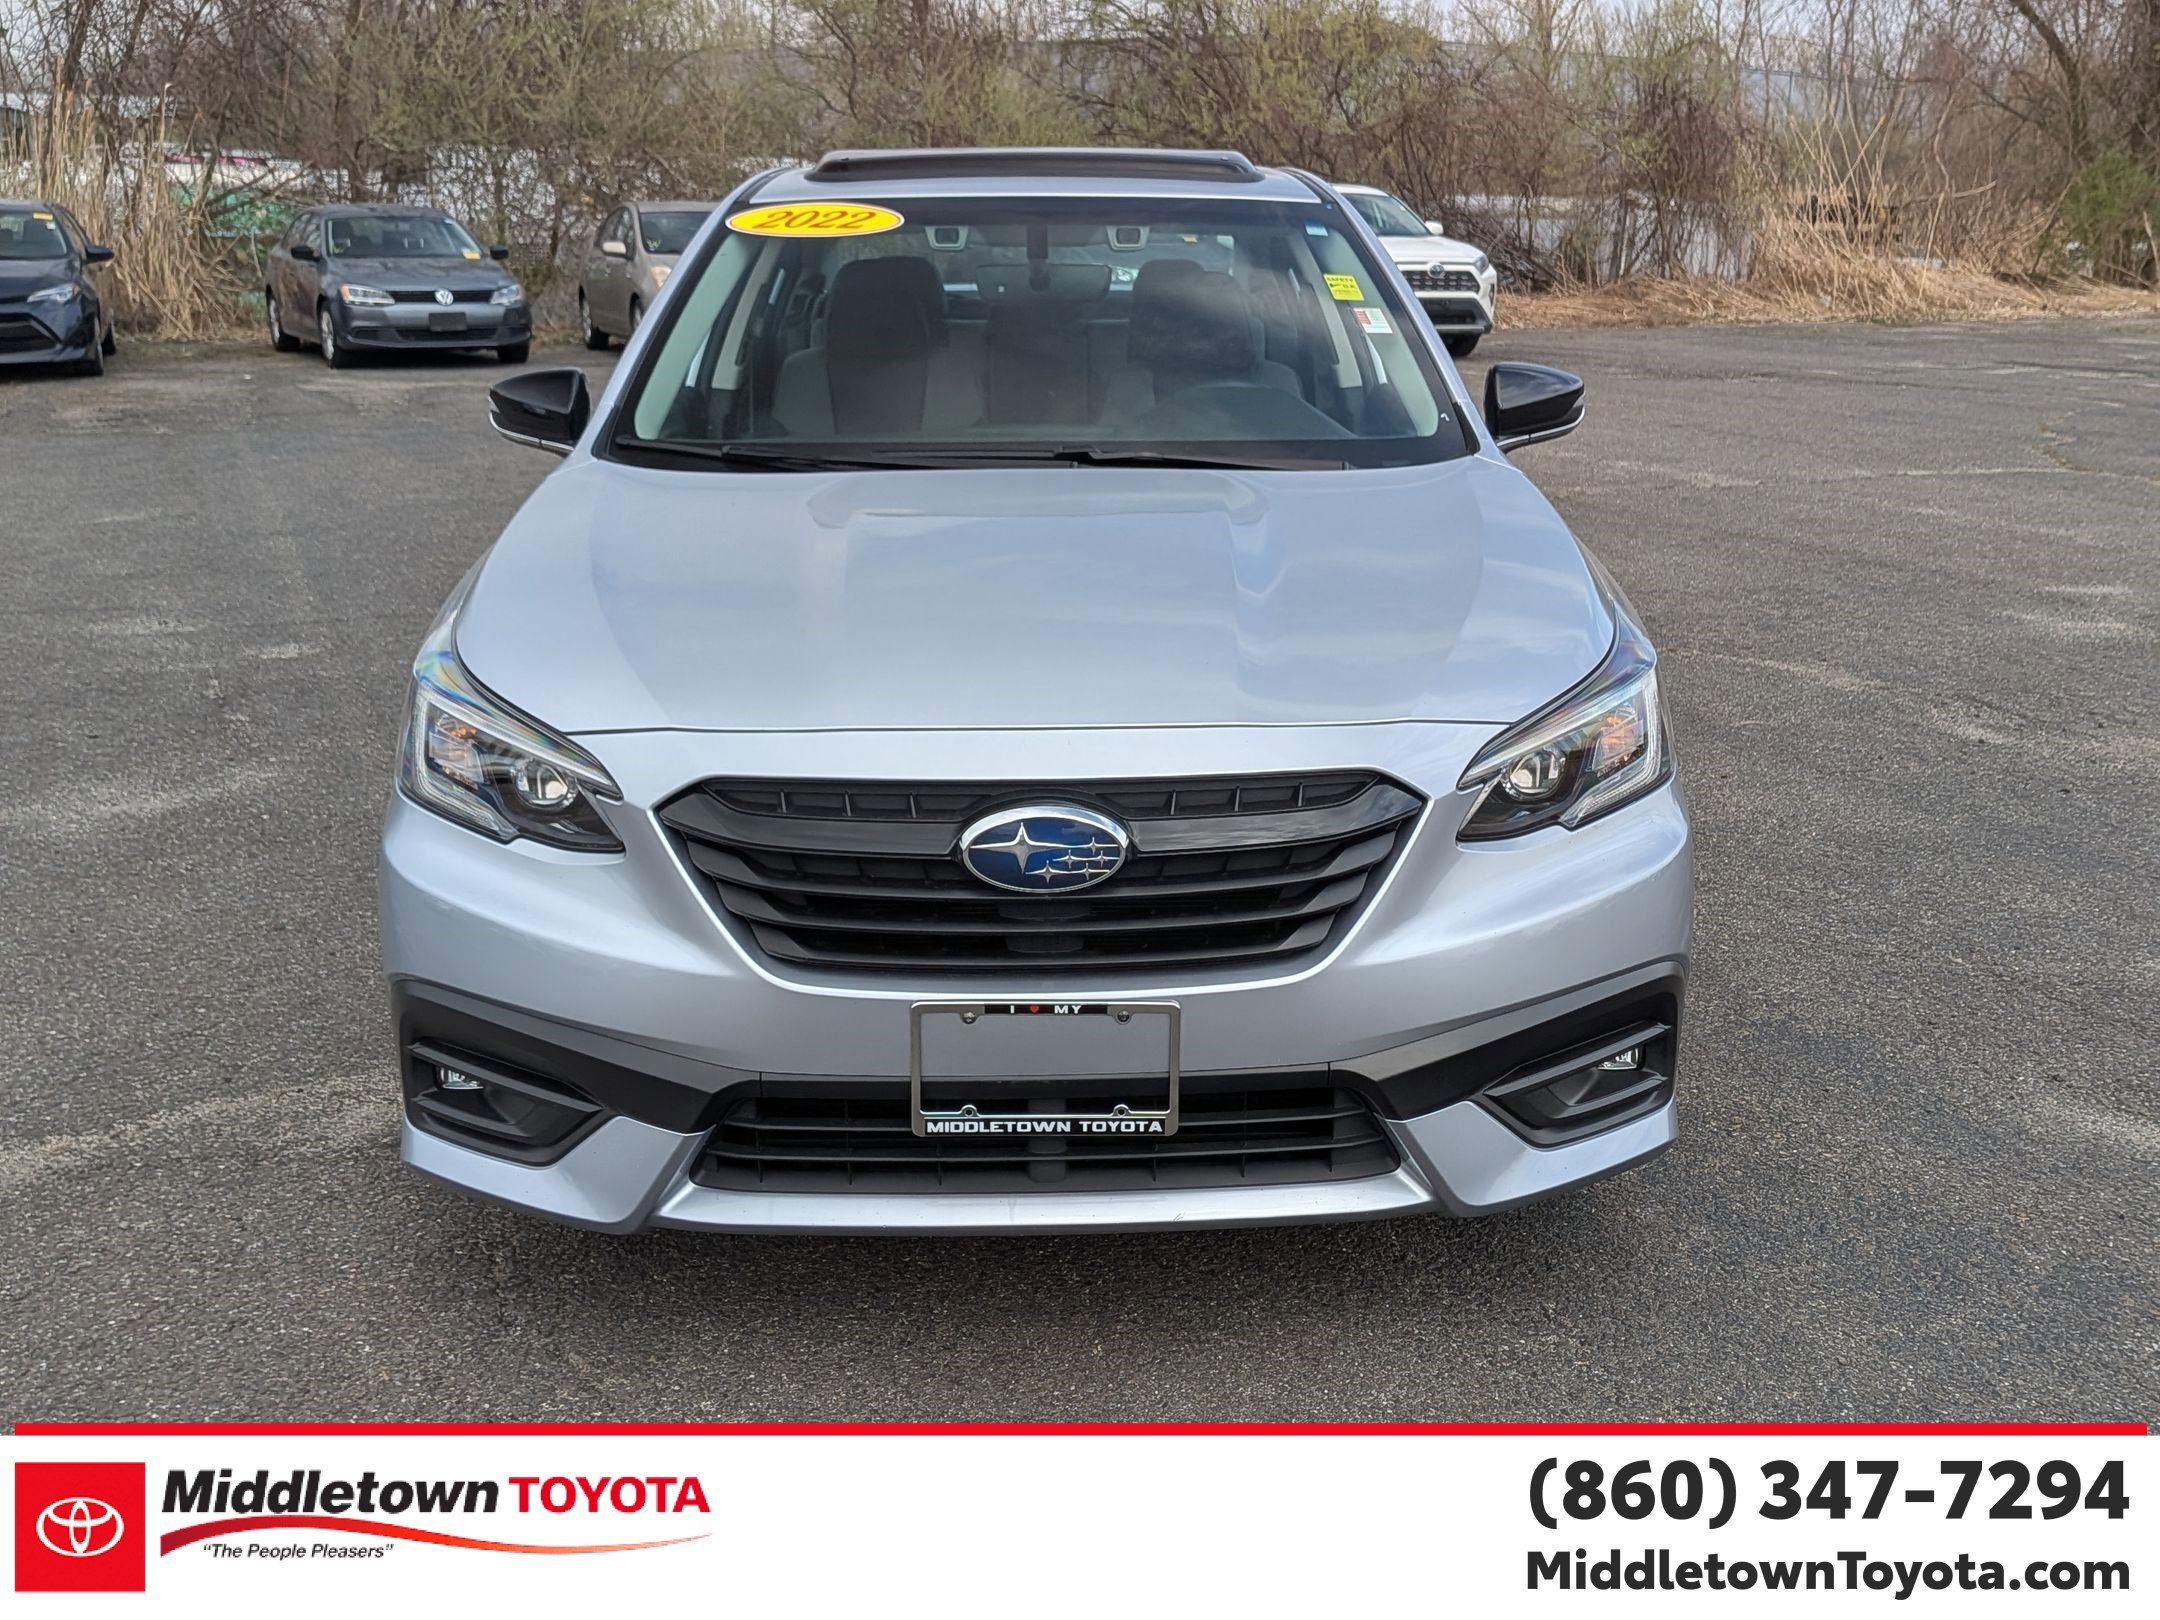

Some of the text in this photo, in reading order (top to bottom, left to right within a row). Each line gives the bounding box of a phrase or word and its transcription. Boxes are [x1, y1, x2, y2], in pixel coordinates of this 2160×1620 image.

[752, 210, 877, 229] 2022
[1010, 1005, 1082, 1014] I MY
[926, 1120, 1163, 1133] MIDDLETOWN TOYOTA
